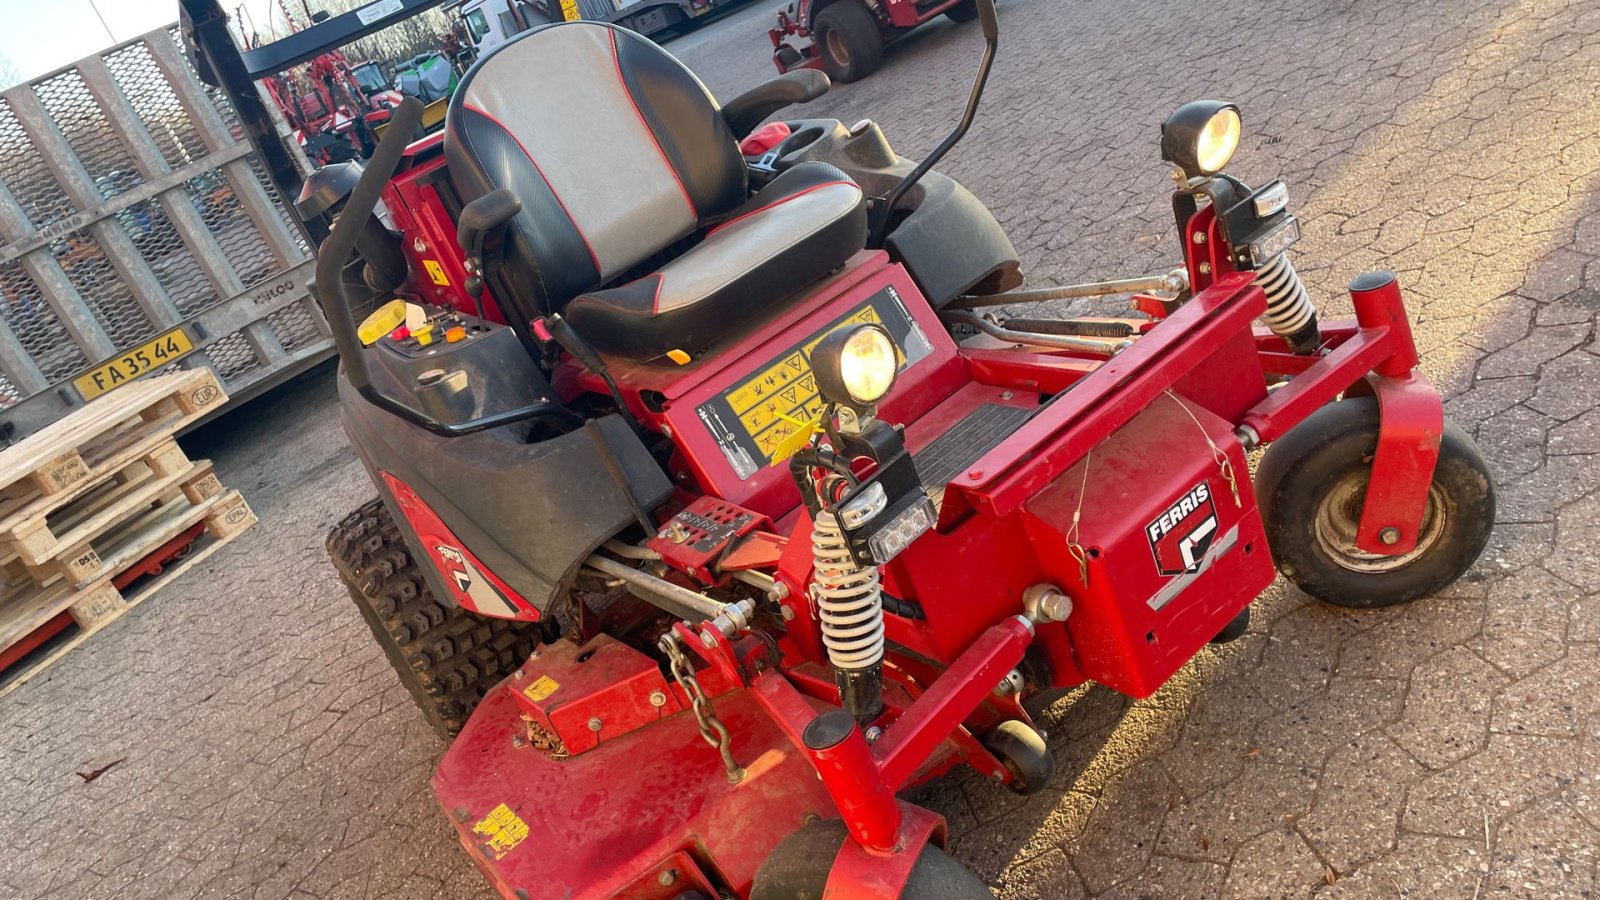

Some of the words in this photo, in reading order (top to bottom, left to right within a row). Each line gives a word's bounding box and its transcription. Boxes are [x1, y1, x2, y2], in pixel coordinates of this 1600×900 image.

[91, 366, 125, 390] FA
[122, 351, 150, 375] 35
[154, 337, 180, 359] 44
[196, 387, 214, 403] EUR
[228, 508, 245, 521] EPAL
[1149, 484, 1208, 543] FERRIS
